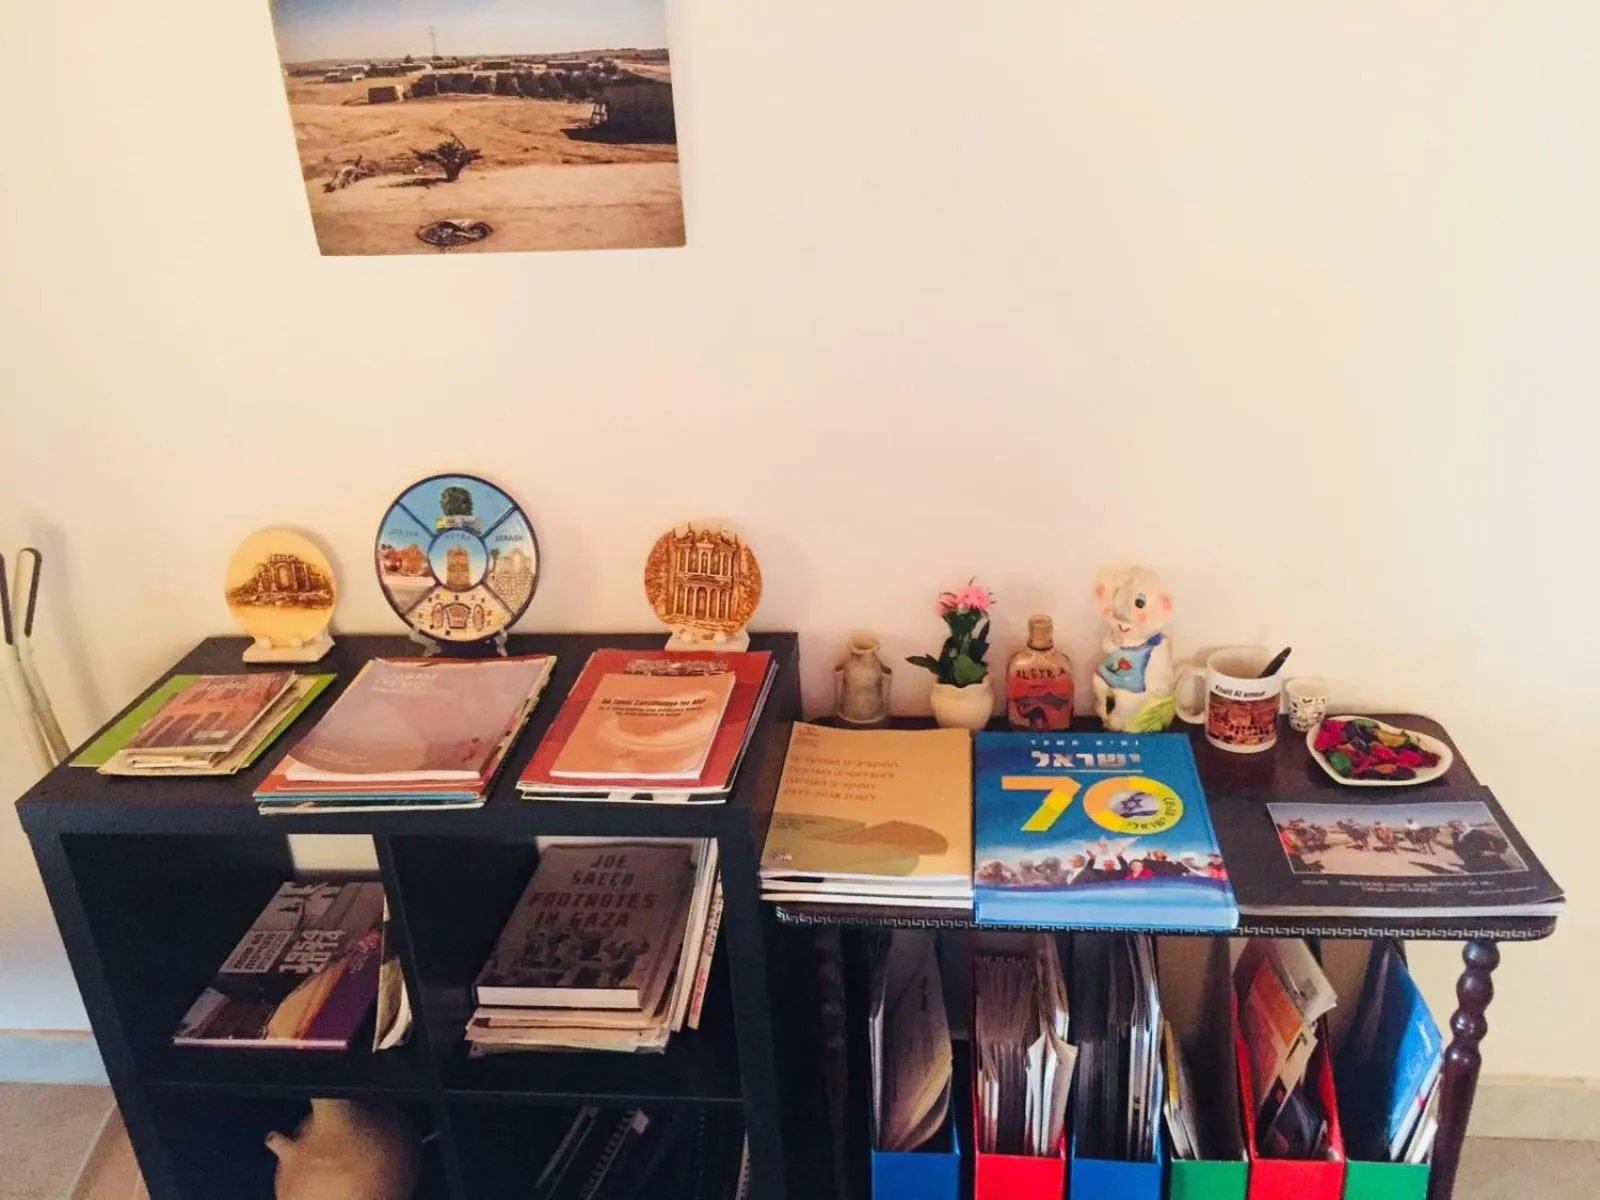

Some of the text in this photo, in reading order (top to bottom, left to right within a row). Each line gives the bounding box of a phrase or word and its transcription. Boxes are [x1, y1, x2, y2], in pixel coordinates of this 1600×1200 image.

[1031, 750, 1141, 767] ישראל
[1001, 775, 1184, 834] 70
[590, 855, 629, 868] JOE
[570, 870, 634, 887] SACCO
[529, 892, 660, 909] FOOTNOTES
[534, 911, 630, 929] IN GAZA
